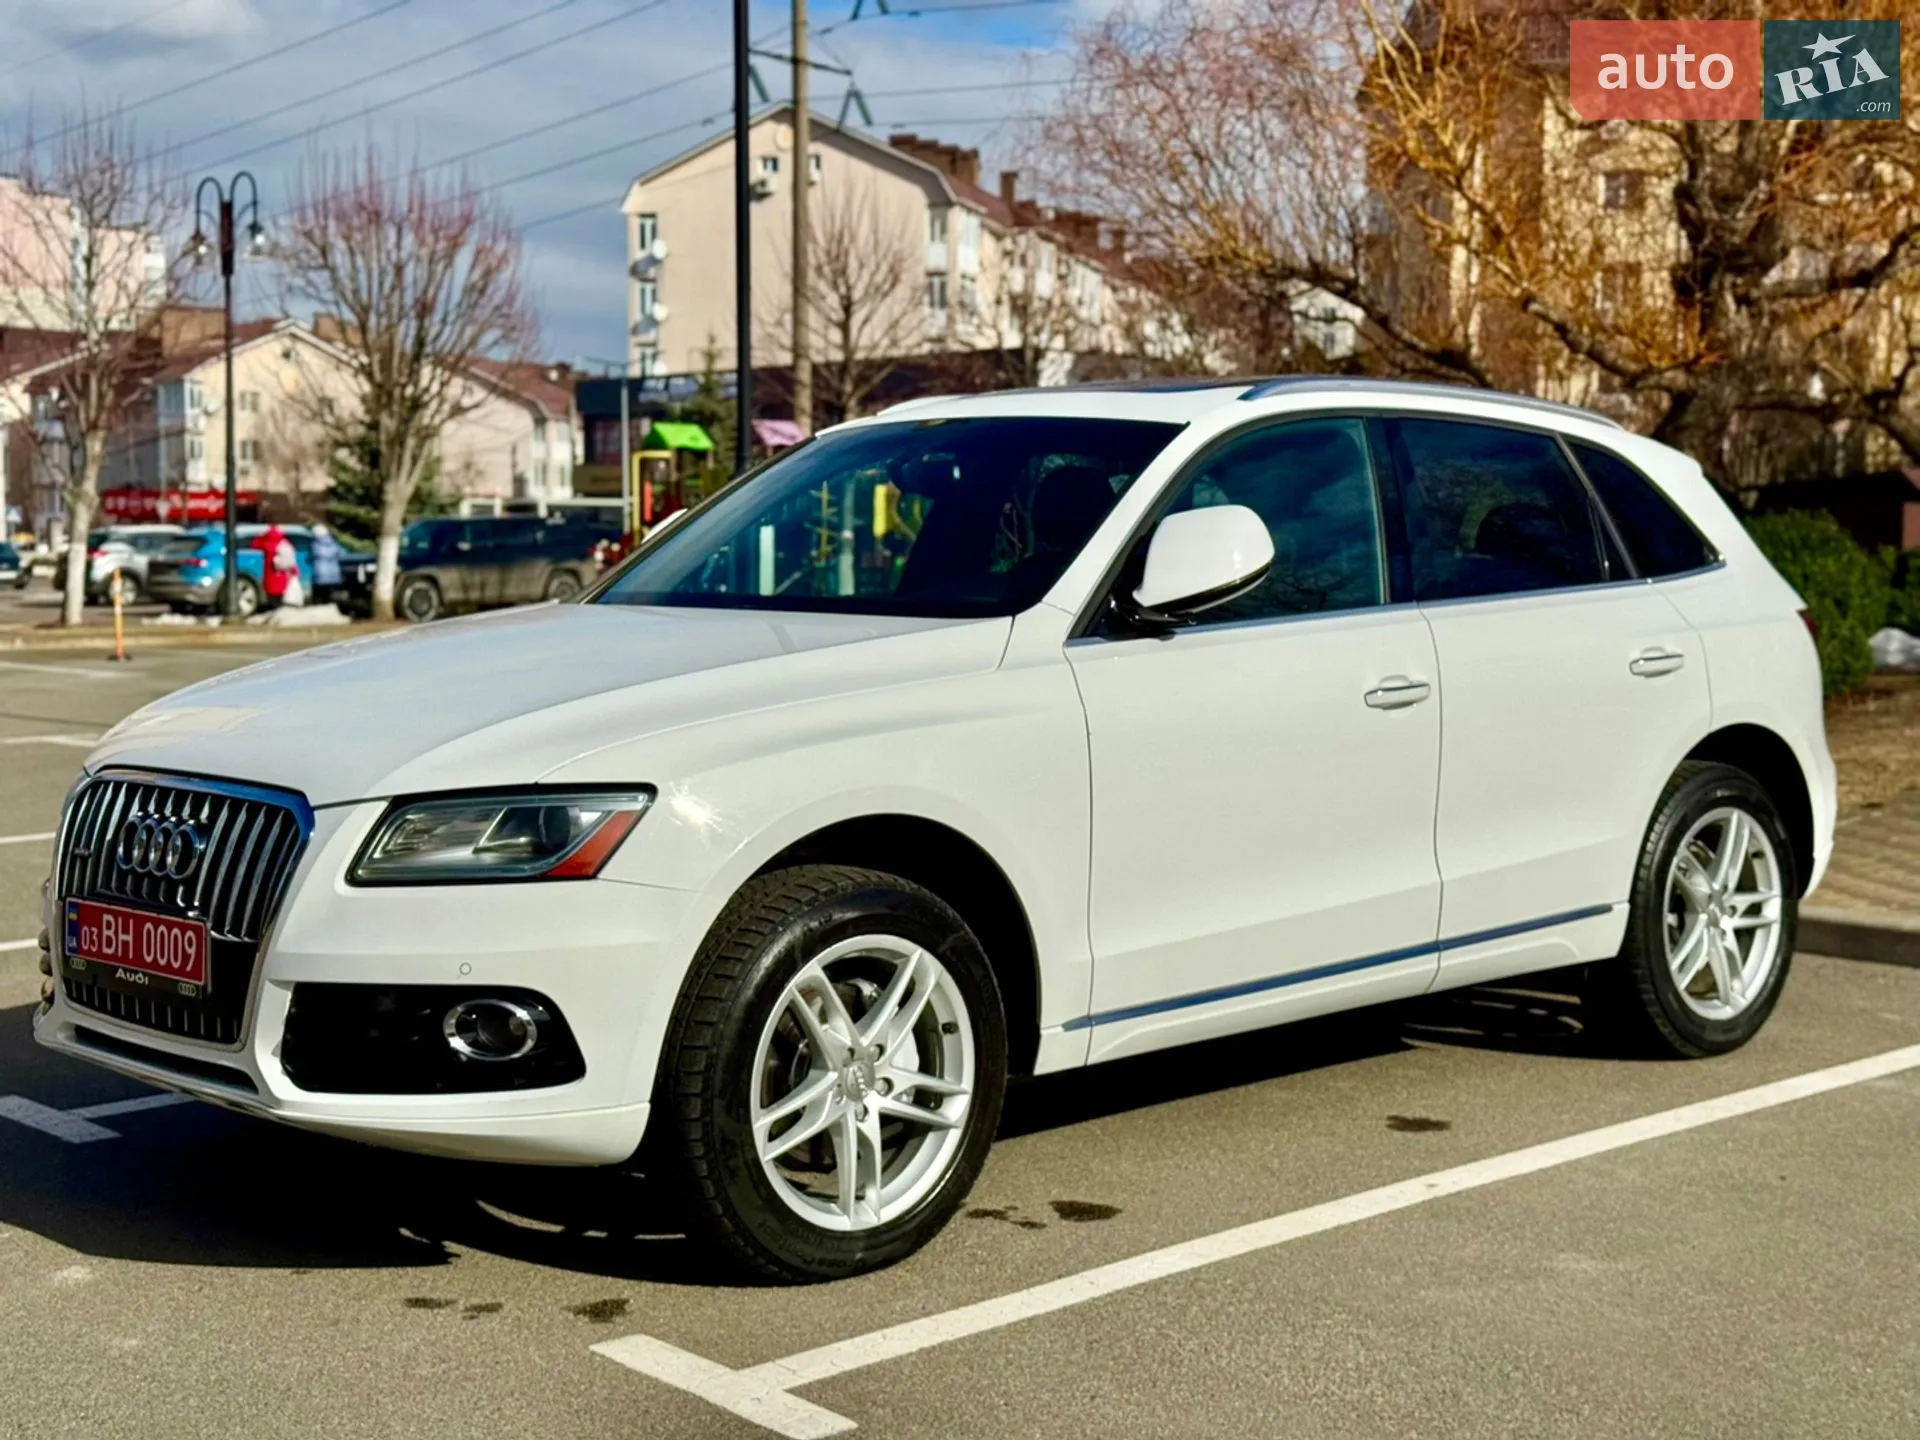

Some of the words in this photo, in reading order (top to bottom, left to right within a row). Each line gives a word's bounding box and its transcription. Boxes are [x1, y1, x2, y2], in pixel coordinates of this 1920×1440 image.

[81, 926, 98, 952] 03
[102, 913, 134, 959] BH
[143, 922, 197, 972] 0009
[115, 967, 149, 985] Audi
